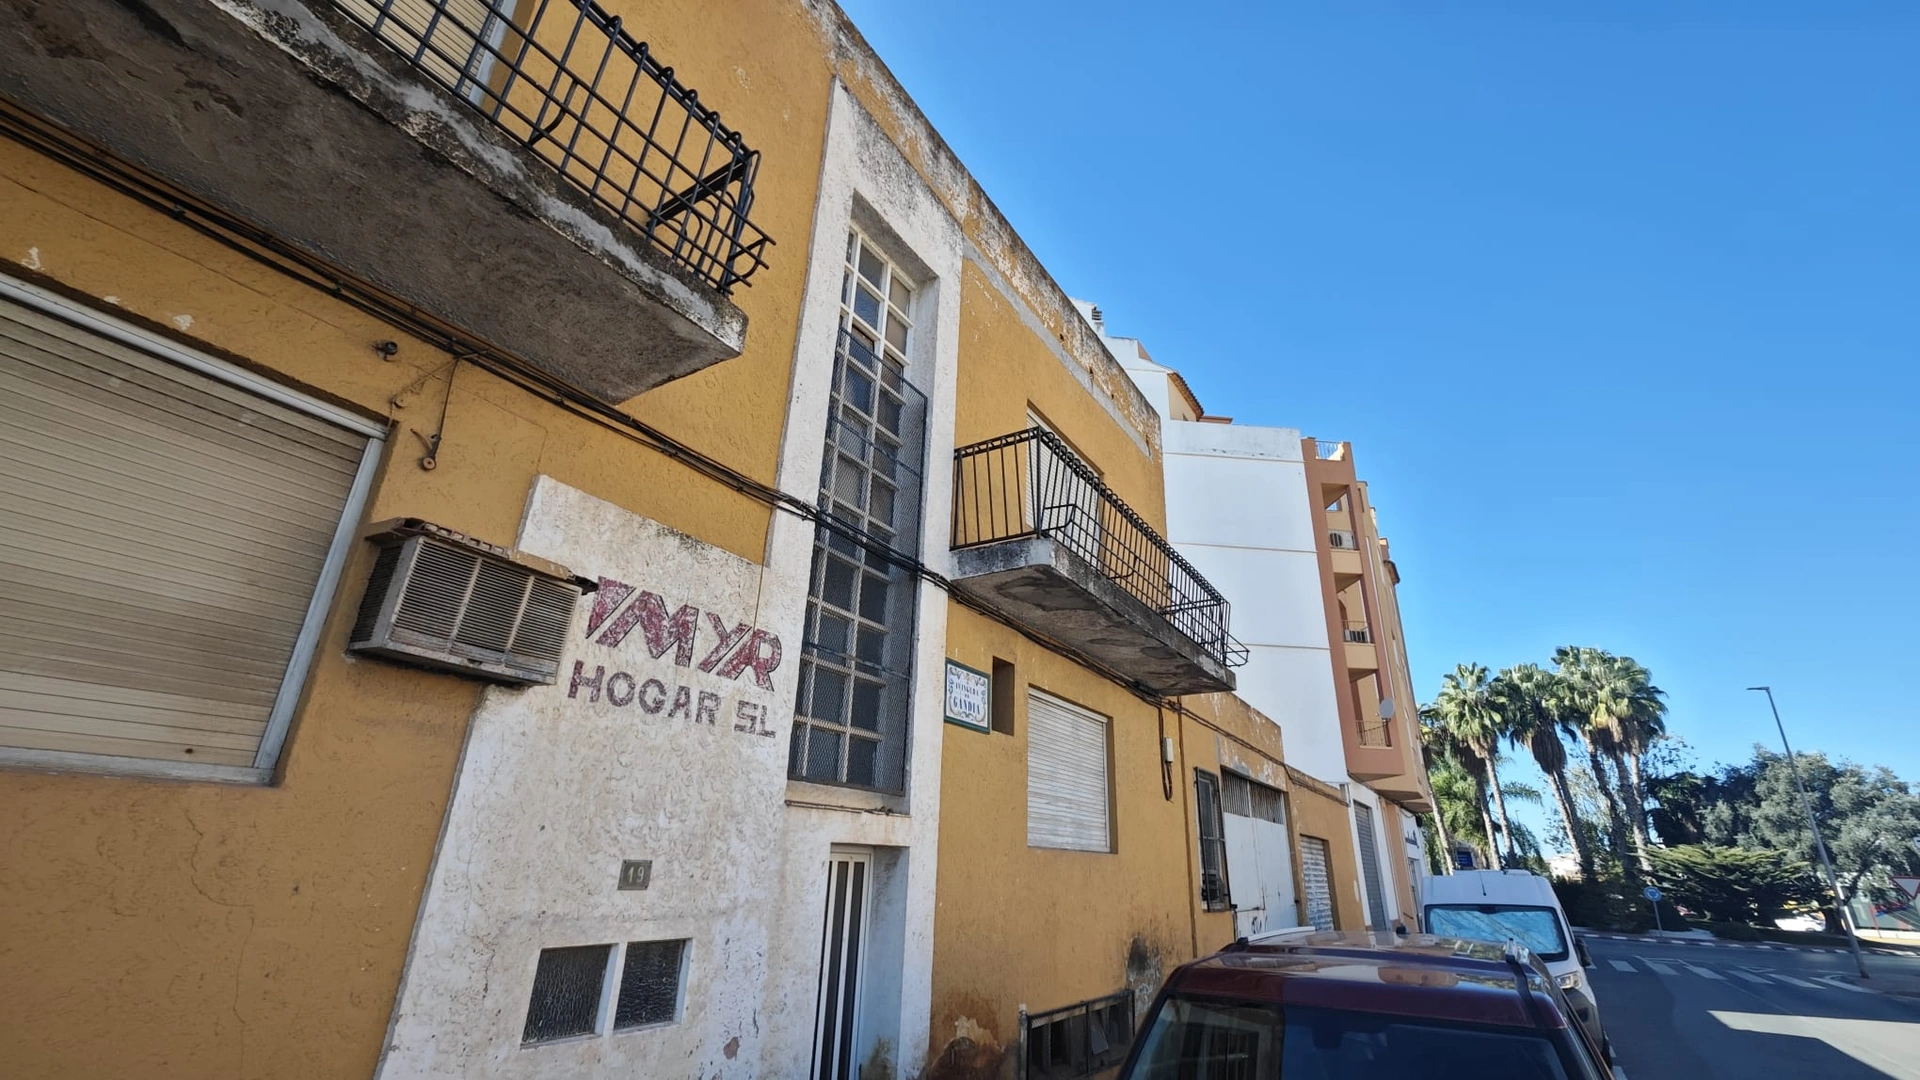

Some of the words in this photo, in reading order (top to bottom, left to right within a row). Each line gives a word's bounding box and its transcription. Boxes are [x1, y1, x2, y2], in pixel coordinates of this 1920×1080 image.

[567, 659, 722, 728] HOGAR
[733, 699, 777, 739] SL
[953, 695, 981, 716] GANDIA
[626, 865, 646, 885] 19
